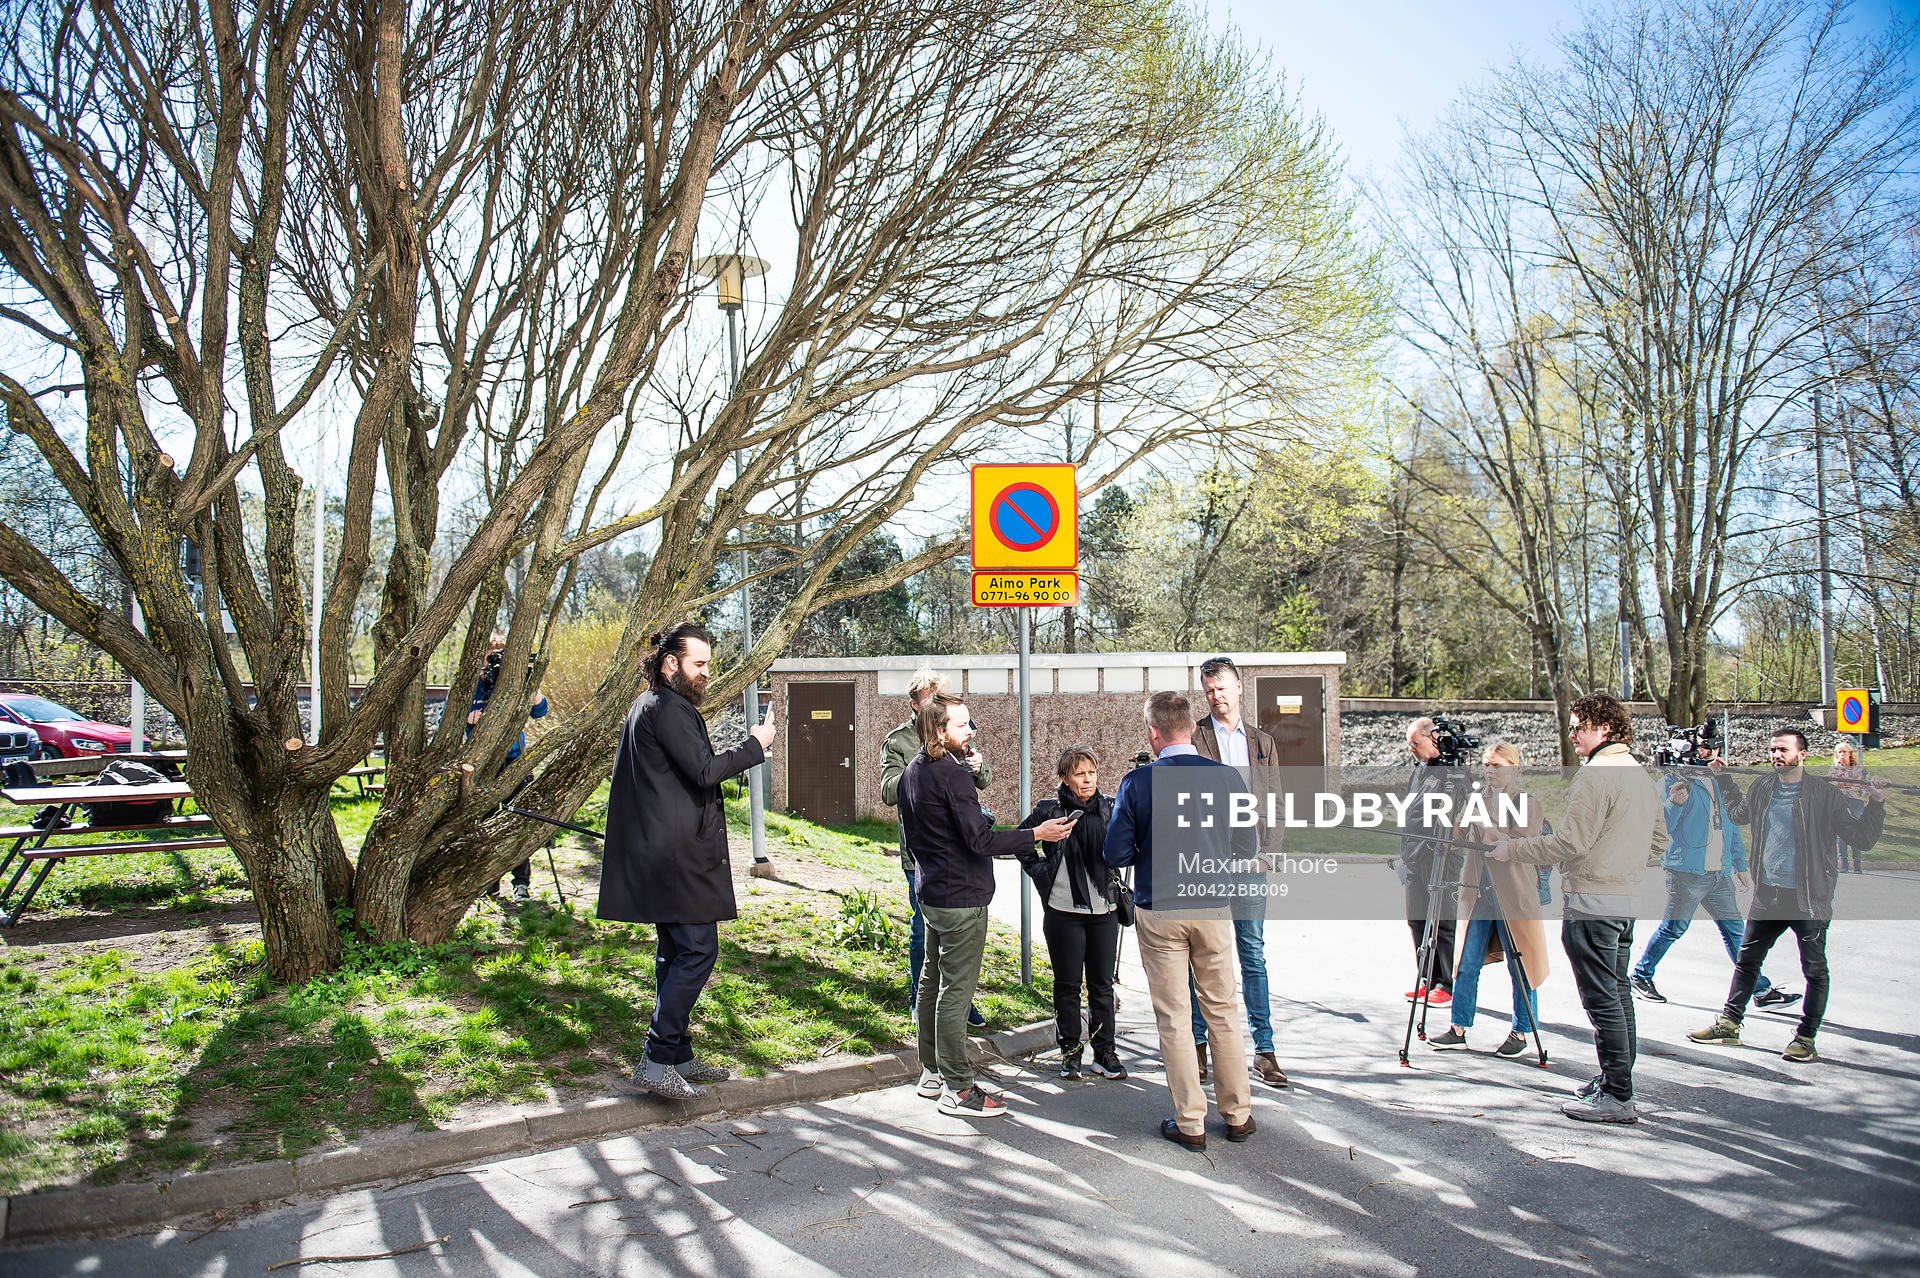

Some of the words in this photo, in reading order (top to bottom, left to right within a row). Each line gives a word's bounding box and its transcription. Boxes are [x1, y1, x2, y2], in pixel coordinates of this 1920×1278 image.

[989, 577, 1024, 589] Aimo
[1030, 577, 1061, 589] Park
[980, 591, 1030, 601] 0771-96
[1033, 591, 1049, 601] 90
[1052, 591, 1070, 601] 00
